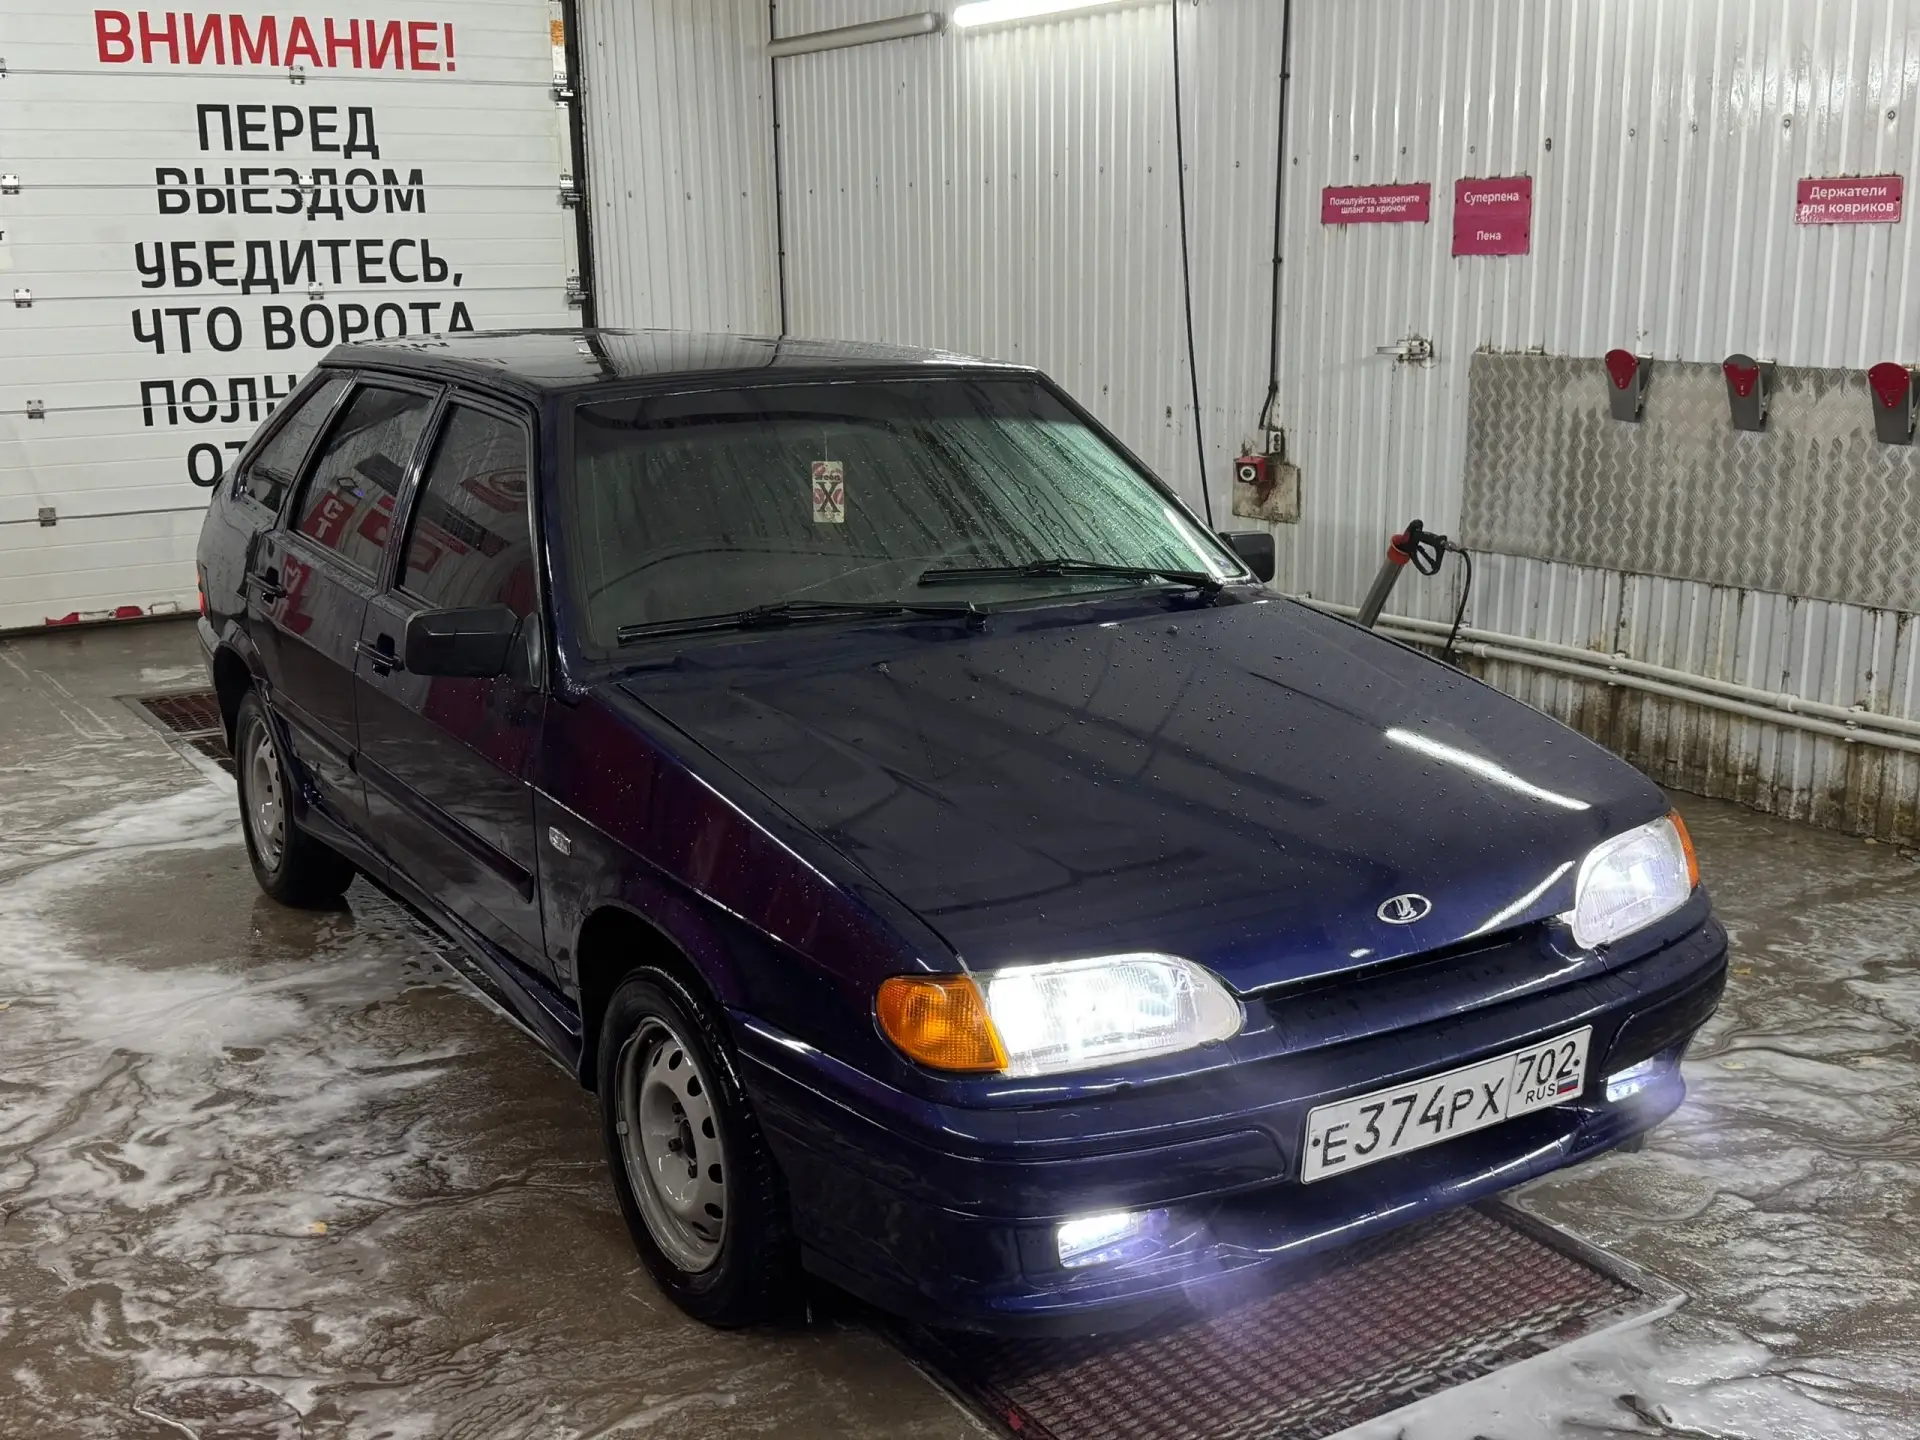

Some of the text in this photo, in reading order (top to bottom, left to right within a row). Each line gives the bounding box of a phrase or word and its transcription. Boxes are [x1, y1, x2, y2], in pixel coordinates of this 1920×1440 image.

[94, 9, 457, 72] ВНИМАНИЕ!
[197, 104, 380, 160] ПЕРЕД
[156, 168, 426, 220] ВЫЕЗДОМ
[1329, 194, 1420, 208] Пожалуйста, закрепите
[1341, 204, 1407, 215] шланг за крючок
[1464, 191, 1520, 206] Суперпена
[1801, 202, 1894, 215] для ковриков
[1810, 186, 1887, 199] Держатели
[1476, 230, 1502, 241] Пена
[135, 239, 463, 294] УБЕДИТЕСЬ,
[132, 301, 474, 354] ЧТО ВОРОТА
[140, 374, 297, 426] ПОЛН
[1515, 1041, 1577, 1094] 702
[1525, 1082, 1556, 1104] RUS
